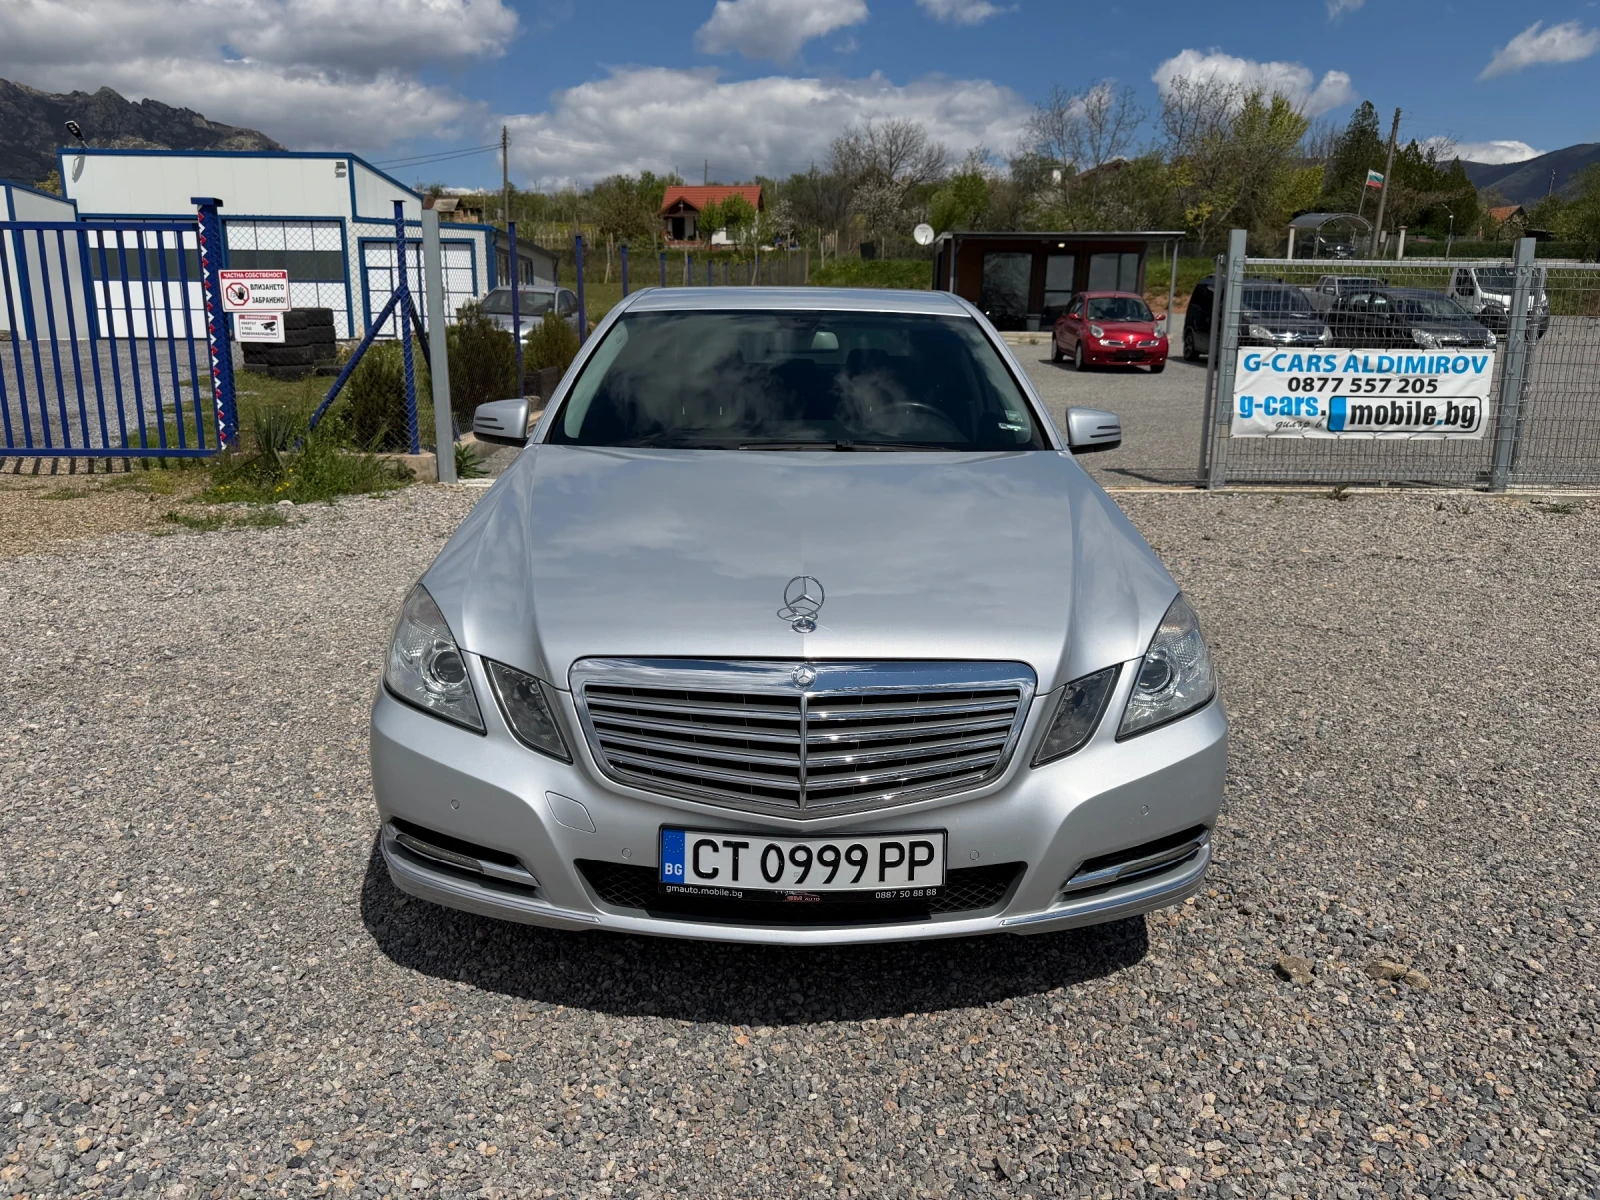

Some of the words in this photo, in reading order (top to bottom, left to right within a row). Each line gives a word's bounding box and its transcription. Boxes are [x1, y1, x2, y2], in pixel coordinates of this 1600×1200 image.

[1243, 353, 1337, 373] G-CARS
[1342, 355, 1488, 374] ALDIMIROV
[1287, 376, 1344, 393] 0877
[1349, 377, 1391, 393] 557
[1396, 378, 1438, 393] 205
[1349, 400, 1476, 428] mobile.bg
[664, 863, 683, 875] BG
[692, 838, 749, 881] CT
[760, 843, 868, 884] 0999
[878, 840, 935, 882] PP
[666, 885, 743, 898] gmauto.mobile.bg
[875, 891, 897, 899] 0887
[899, 890, 910, 898] 50
